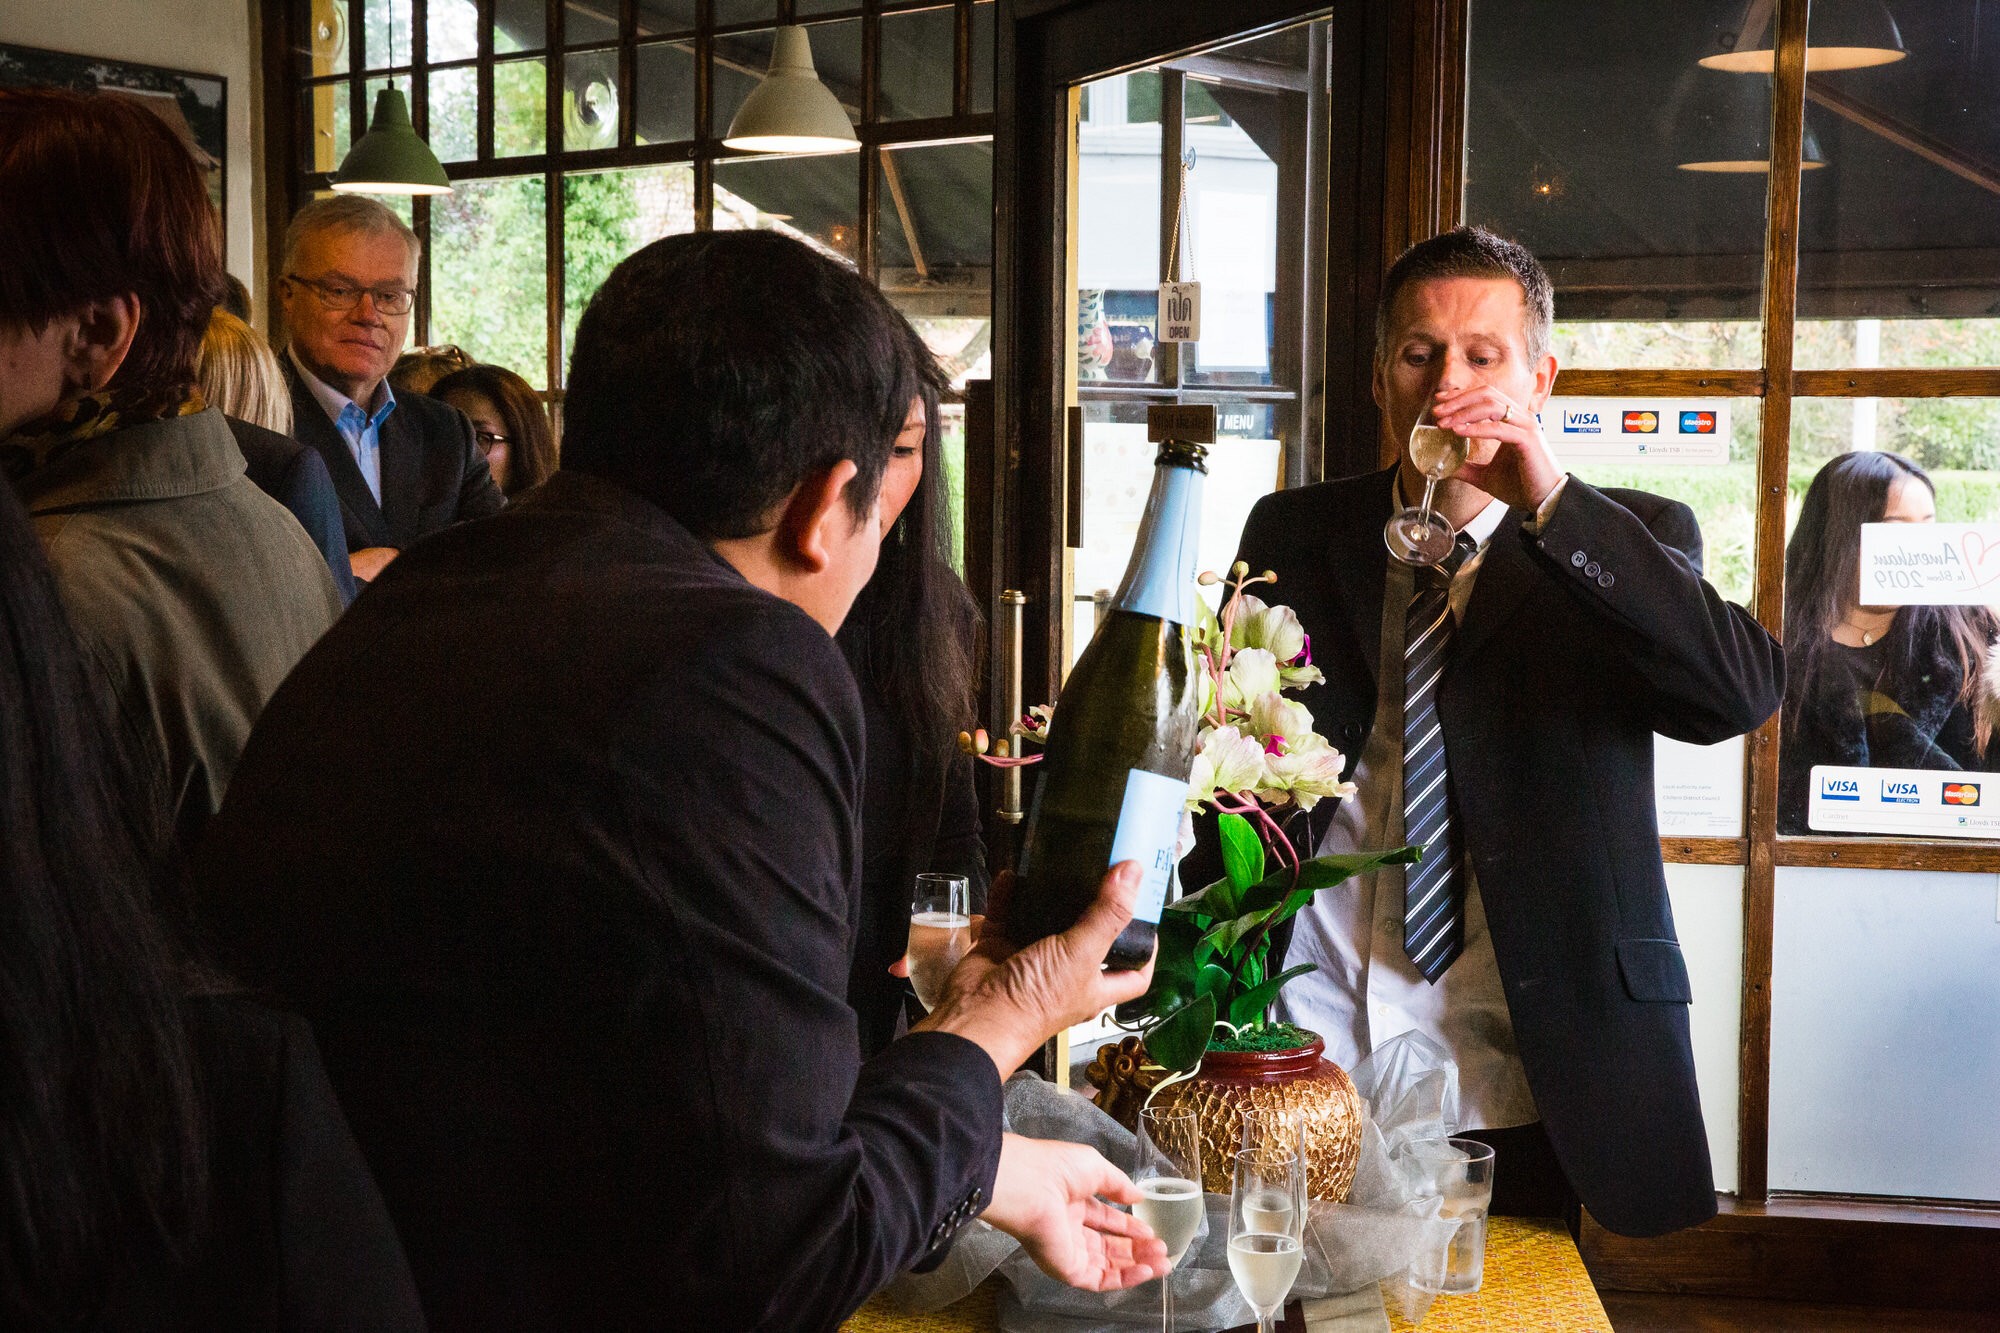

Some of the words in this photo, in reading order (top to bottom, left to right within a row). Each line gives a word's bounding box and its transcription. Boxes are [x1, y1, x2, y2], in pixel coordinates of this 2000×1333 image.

[1168, 286, 1192, 322] เปิด
[1169, 326, 1190, 339] OPEN
[1224, 414, 1254, 430] MENU
[1569, 412, 1600, 425] VISA
[1684, 419, 1712, 427] Maestro
[1828, 780, 1858, 792] VISA
[1887, 783, 1919, 795] VISA
